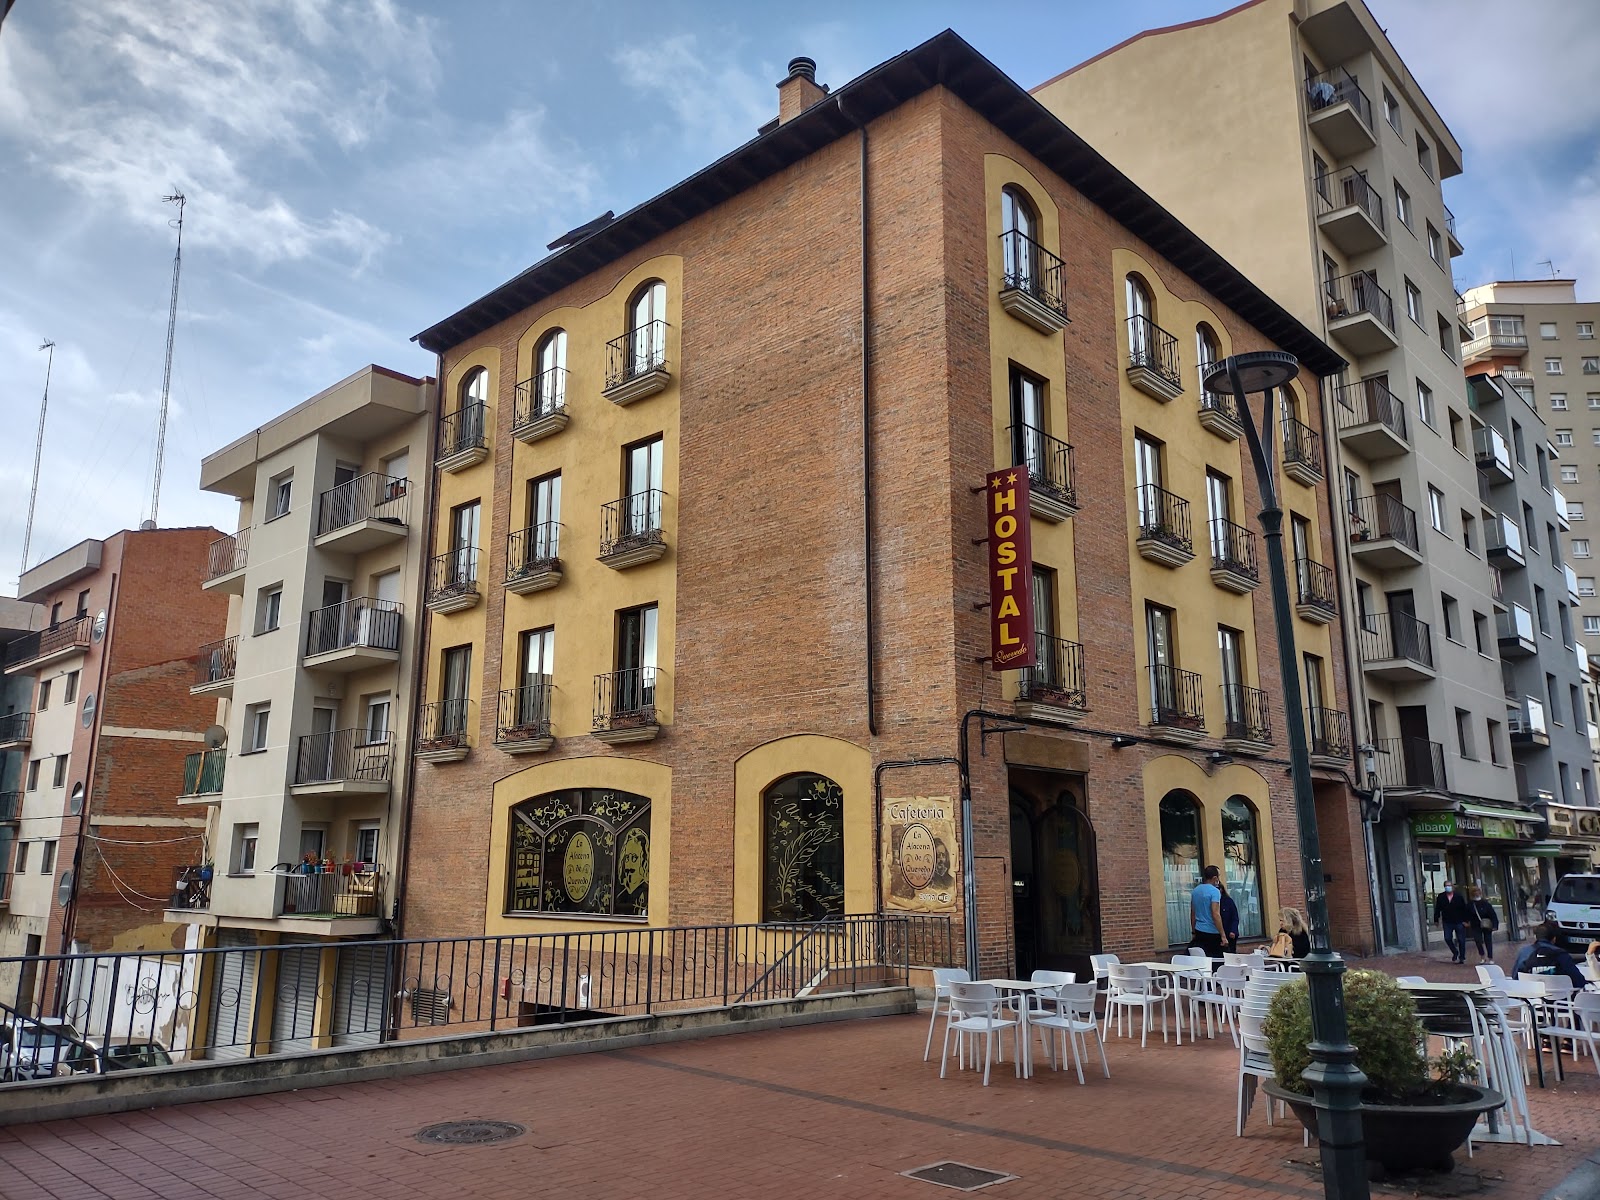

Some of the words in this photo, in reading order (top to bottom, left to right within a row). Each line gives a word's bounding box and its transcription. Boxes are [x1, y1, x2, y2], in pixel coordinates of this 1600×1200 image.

[994, 488, 1021, 646] HOSTAL
[1415, 822, 1452, 834] albany
[913, 831, 922, 839] La
[905, 865, 931, 874] Quevedo
